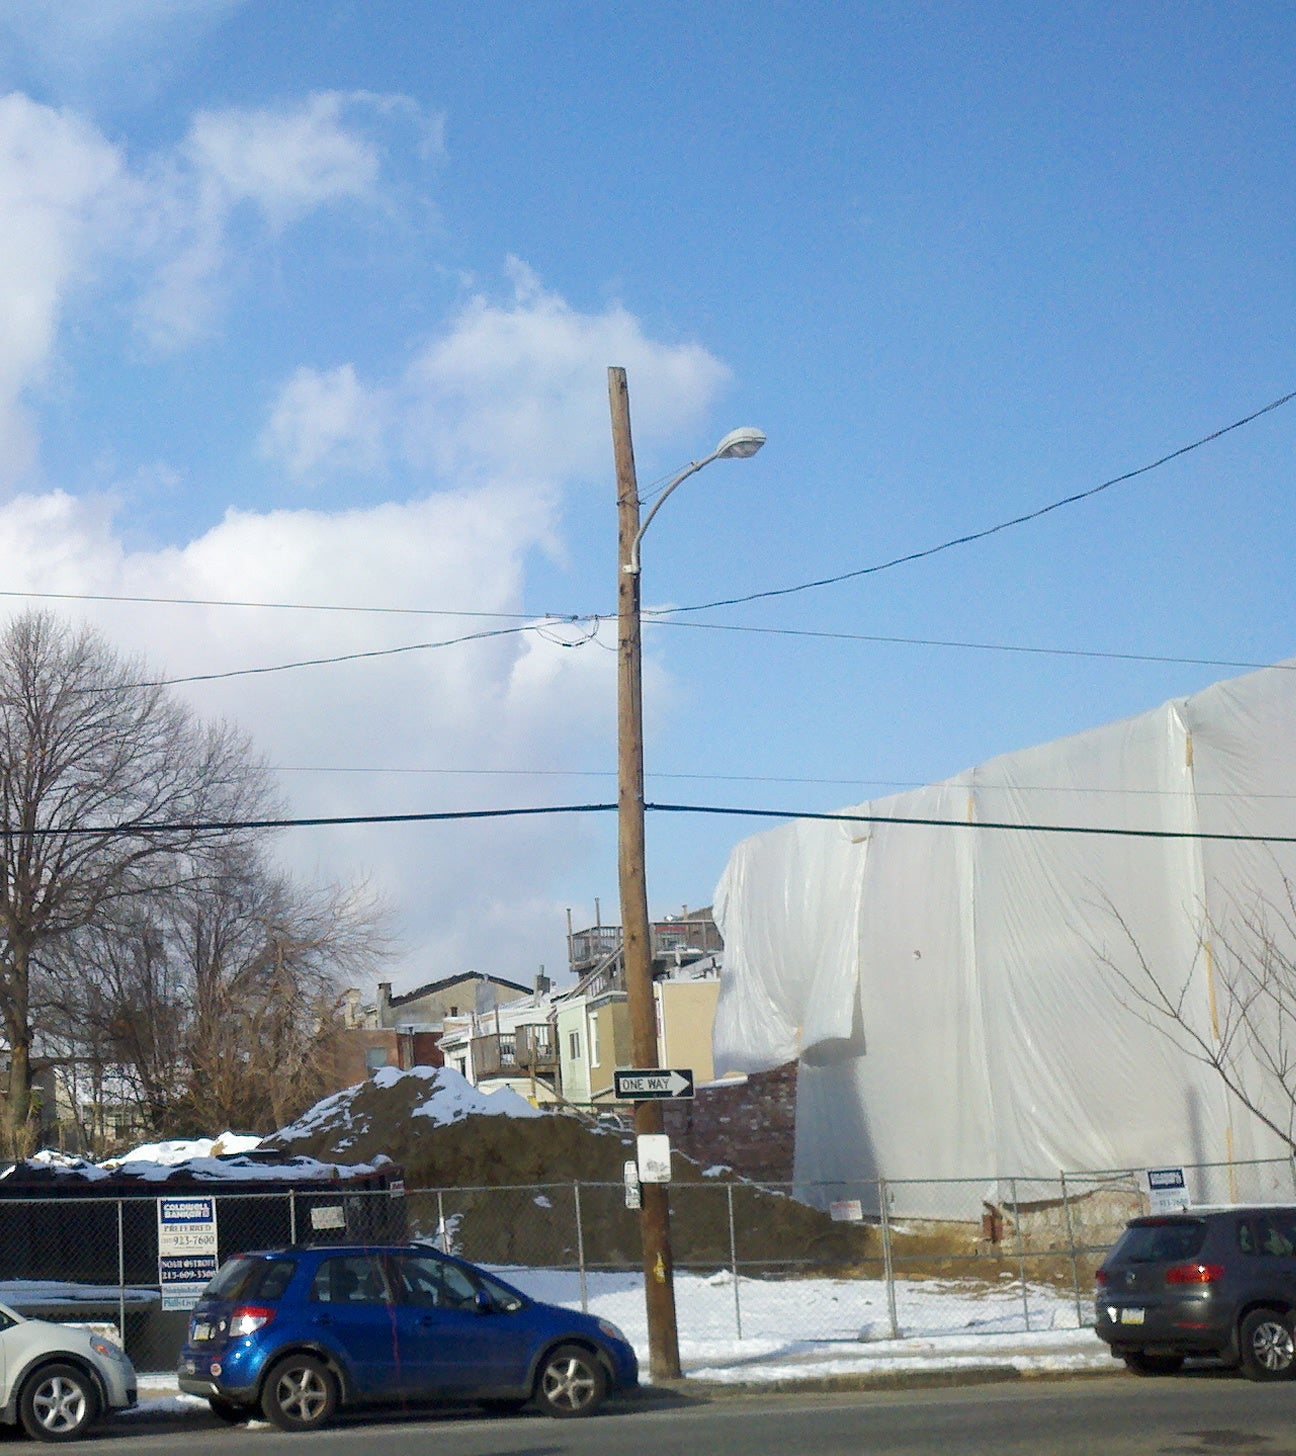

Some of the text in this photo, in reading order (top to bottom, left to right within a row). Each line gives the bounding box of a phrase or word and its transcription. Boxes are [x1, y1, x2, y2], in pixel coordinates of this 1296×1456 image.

[623, 1079, 669, 1090] ONE WAY
[164, 1203, 208, 1212] COLDWELL
[164, 1210, 203, 1219] BANKER
[173, 1236, 215, 1246] 923-7600
[163, 1260, 183, 1269] NOAH
